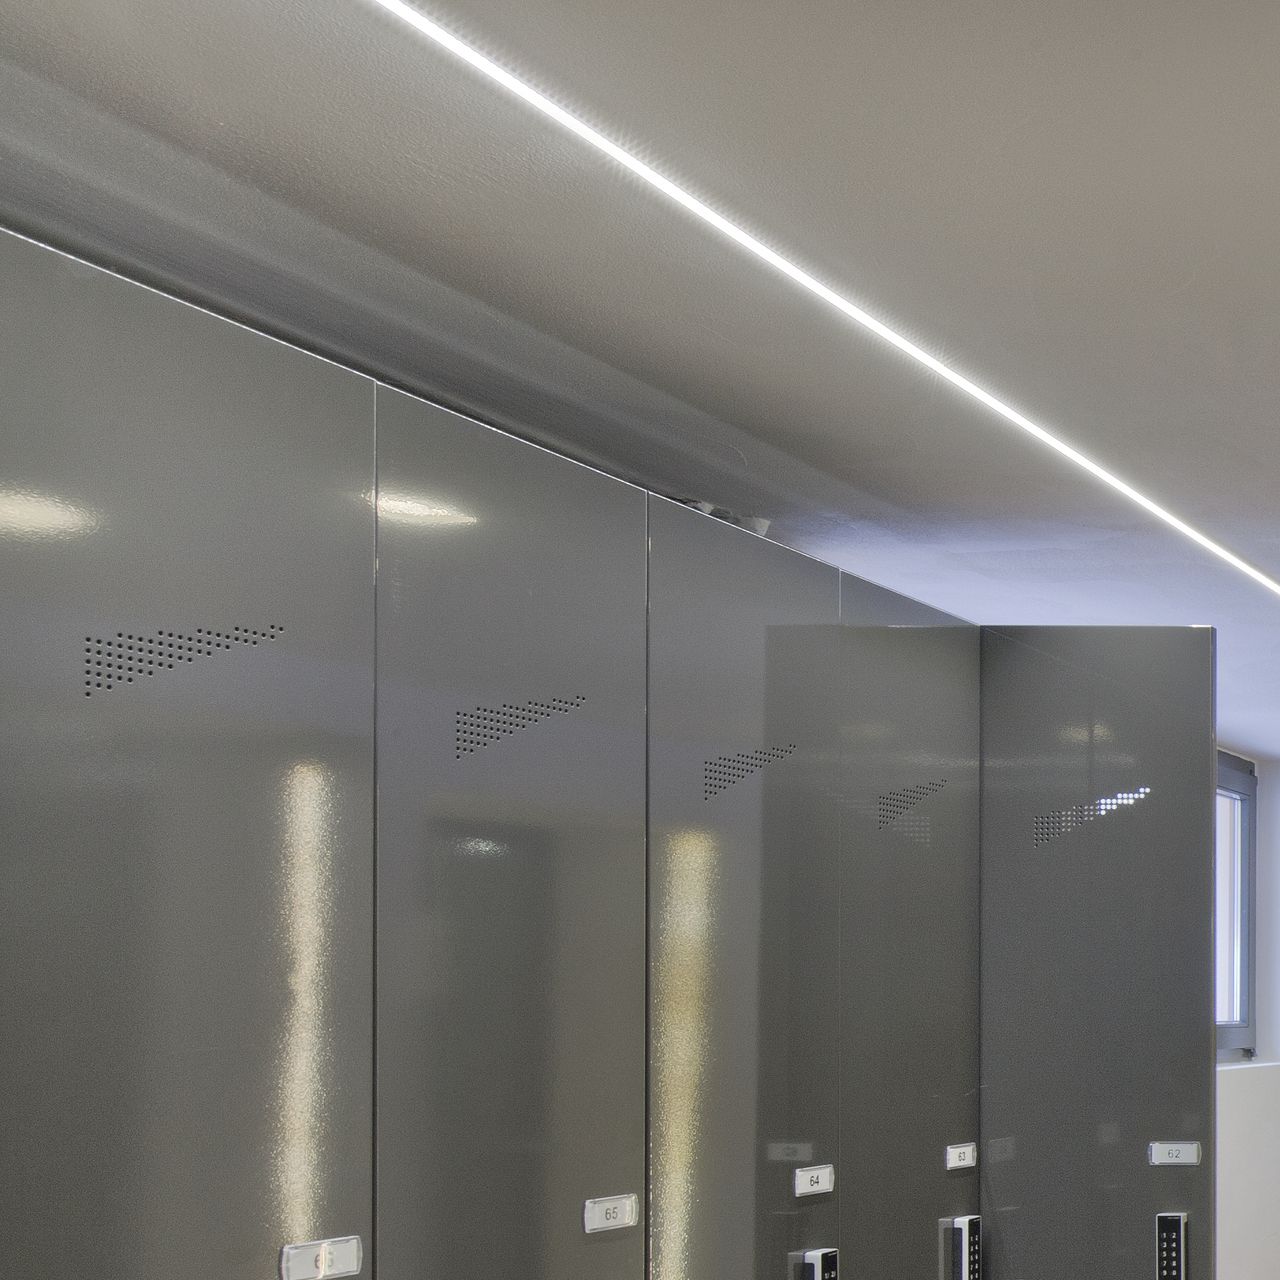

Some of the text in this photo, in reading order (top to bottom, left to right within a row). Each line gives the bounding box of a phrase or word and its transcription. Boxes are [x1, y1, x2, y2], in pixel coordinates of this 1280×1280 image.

[958, 1151, 966, 1162] 63
[1168, 1149, 1181, 1159] 62
[809, 1175, 820, 1187] 64
[604, 1206, 618, 1221] 65
